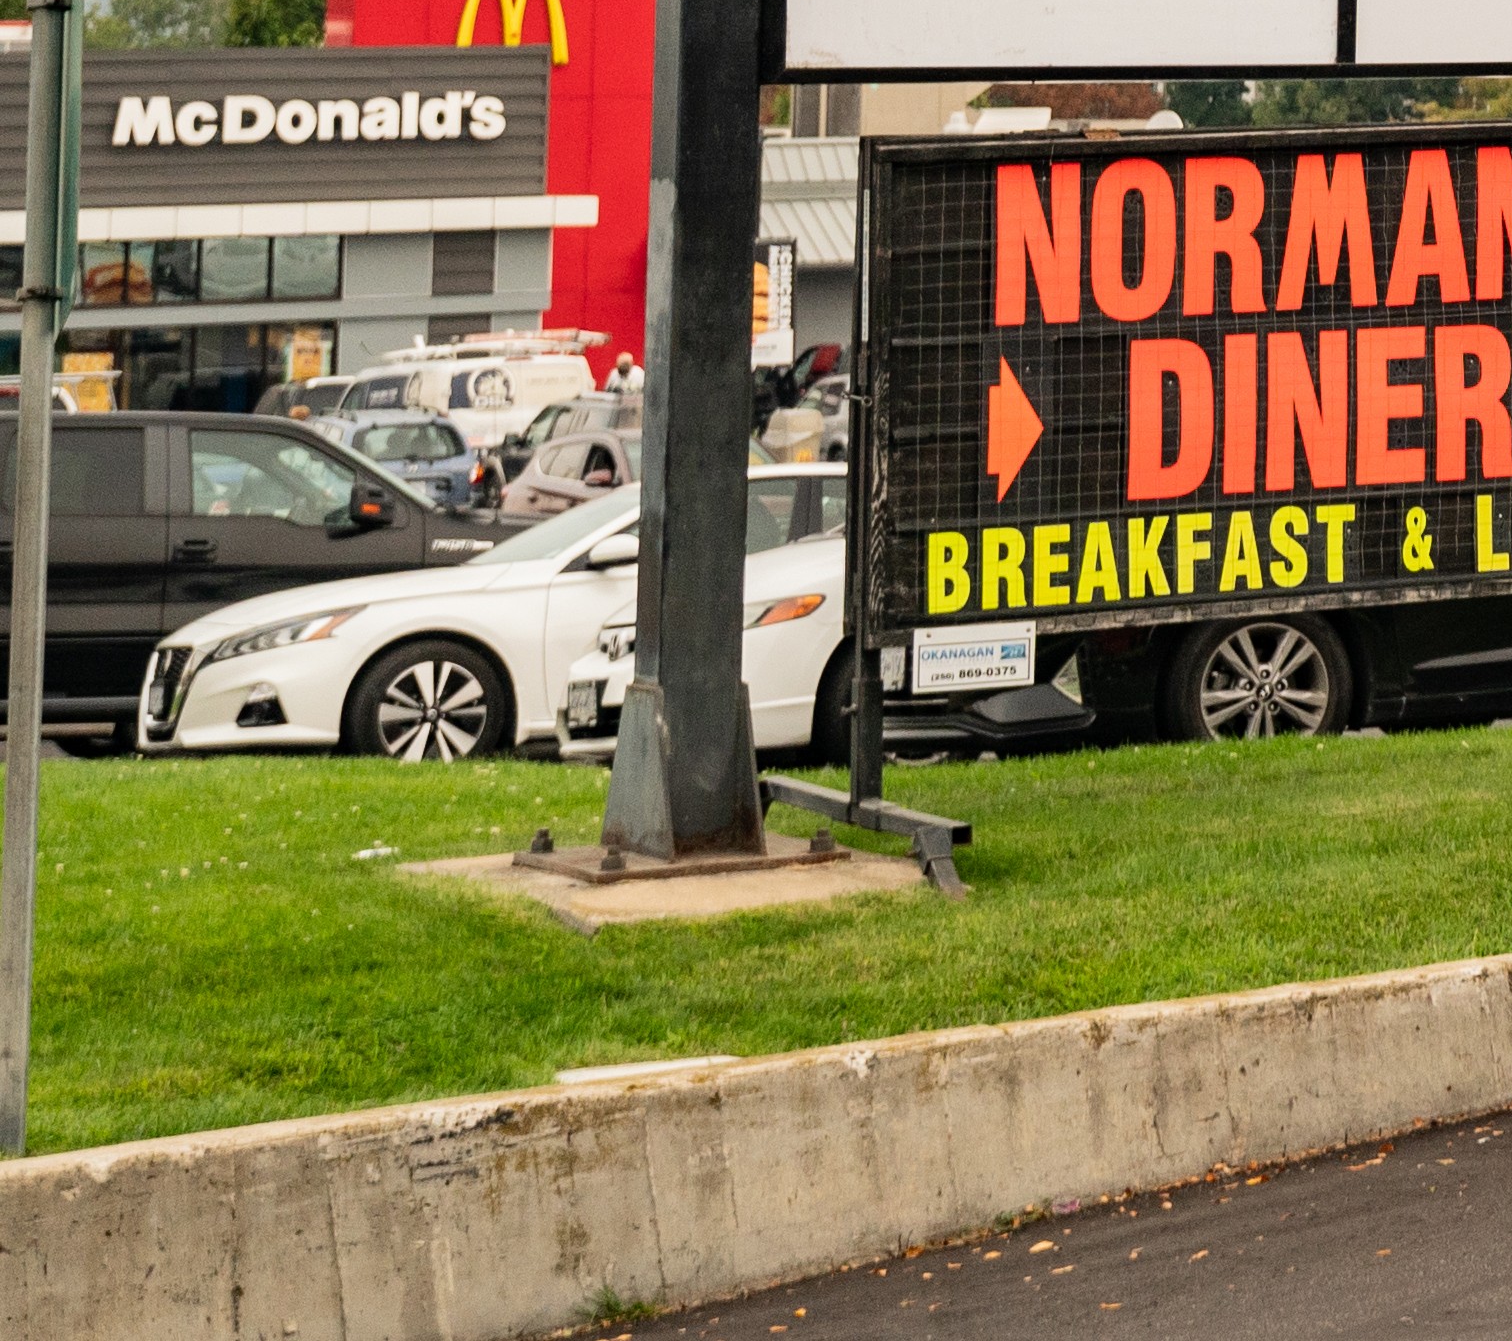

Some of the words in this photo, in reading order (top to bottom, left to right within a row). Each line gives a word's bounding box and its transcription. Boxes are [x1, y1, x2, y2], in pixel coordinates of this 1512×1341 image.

[112, 90, 507, 147] McDonald's
[927, 503, 1357, 615] BREAKFAST
[1401, 506, 1437, 573] &
[921, 646, 995, 661] OKANAGAN
[959, 666, 1017, 678] 869-0375
